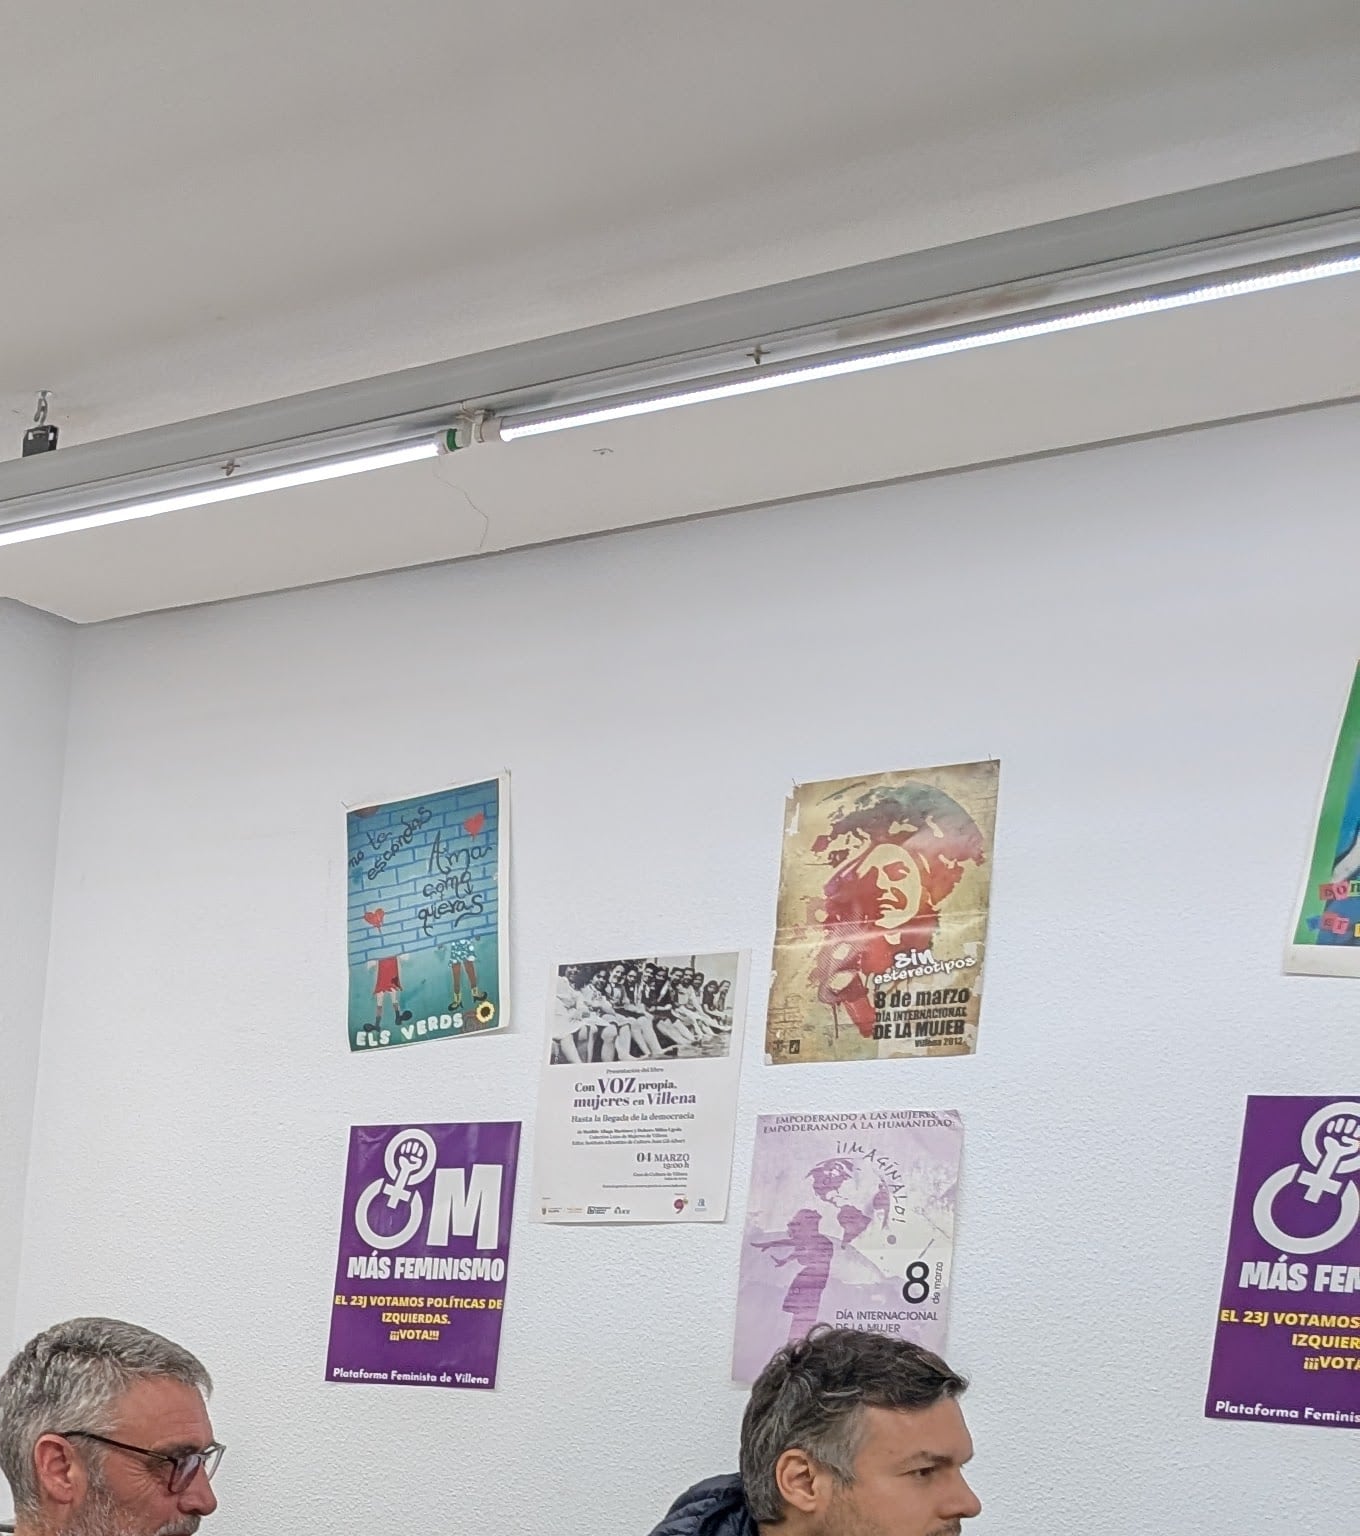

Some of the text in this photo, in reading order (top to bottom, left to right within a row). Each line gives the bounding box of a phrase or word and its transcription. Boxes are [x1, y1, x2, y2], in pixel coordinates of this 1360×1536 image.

[894, 948, 936, 969] sin
[873, 955, 976, 985] estereotipos
[875, 988, 970, 1009] 8 de marzo
[875, 1007, 967, 1023] DÍA INTERNACIONAL
[356, 1013, 464, 1046] ELS VERDS
[873, 1019, 965, 1040] DE LA MUJER
[574, 1082, 595, 1093] Con
[598, 1077, 636, 1094] VOZ
[573, 1091, 697, 1110] mujeres en Villena
[571, 1115, 593, 1123] Hasta
[594, 1114, 601, 1122] la
[630, 1113, 640, 1121] de
[641, 1112, 648, 1121] la
[649, 1111, 695, 1120] democracia
[776, 1113, 858, 1125] EMPODERANDO
[870, 1111, 887, 1120] LAS
[763, 1122, 847, 1134] EMPODERANDO
[850, 1122, 857, 1130] A
[861, 1121, 873, 1129] LA
[654, 1153, 690, 1162] MARZO
[347, 1250, 505, 1280] MÁS FEMINISMO
[1238, 1254, 1308, 1291] MÁS
[902, 1261, 944, 1304] 8 de marzo
[335, 1295, 502, 1309] EL 23J VOTAMOS POLÍTICAS DE
[382, 1312, 452, 1325] IZQUIERDAS.
[835, 1309, 938, 1321] DÍA INTERNACIONAL
[1220, 1310, 1360, 1329] EL 23J VOTAMOS
[867, 1323, 901, 1332] MUJER
[333, 1367, 490, 1385] Plataforma Feminista de Villena
[1215, 1401, 1299, 1419] Plataforma
